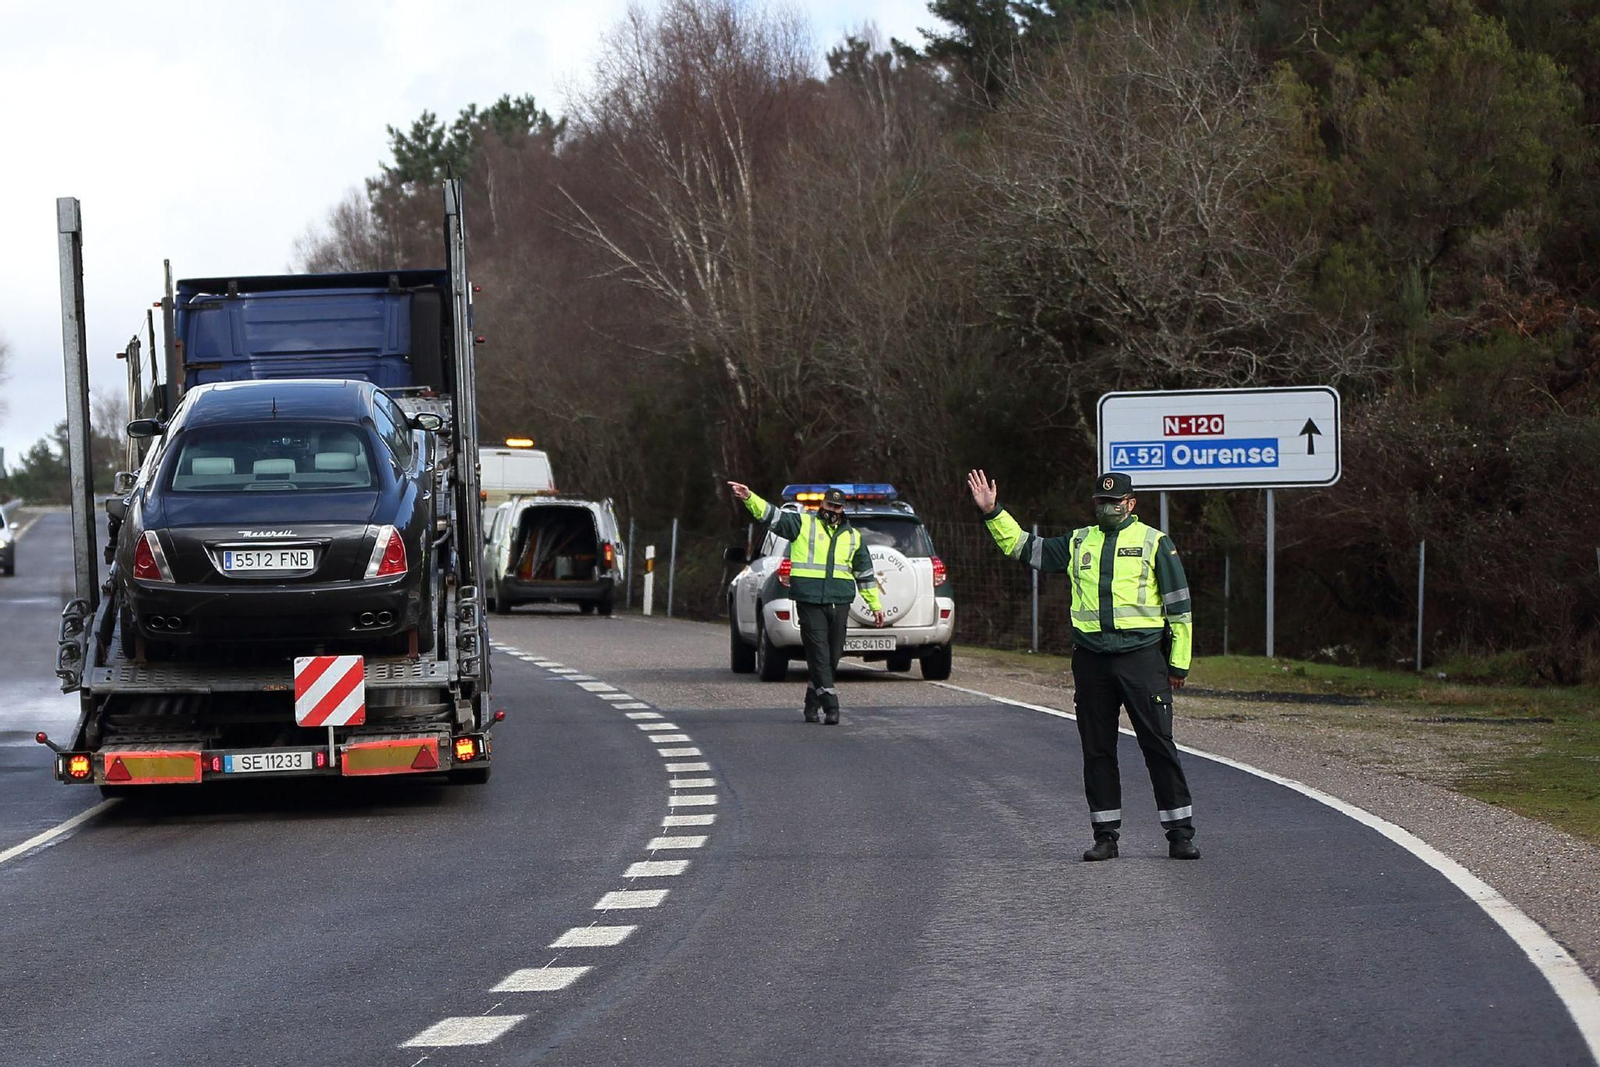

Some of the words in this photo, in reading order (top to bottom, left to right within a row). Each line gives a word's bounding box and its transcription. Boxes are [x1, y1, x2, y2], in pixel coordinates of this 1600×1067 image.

[1164, 417, 1223, 434] N-120
[1115, 448, 1162, 465] A-52
[1171, 444, 1276, 466] Ourense
[236, 553, 273, 567] 5512
[280, 552, 309, 566] FNB
[887, 555, 905, 572] CIVIL
